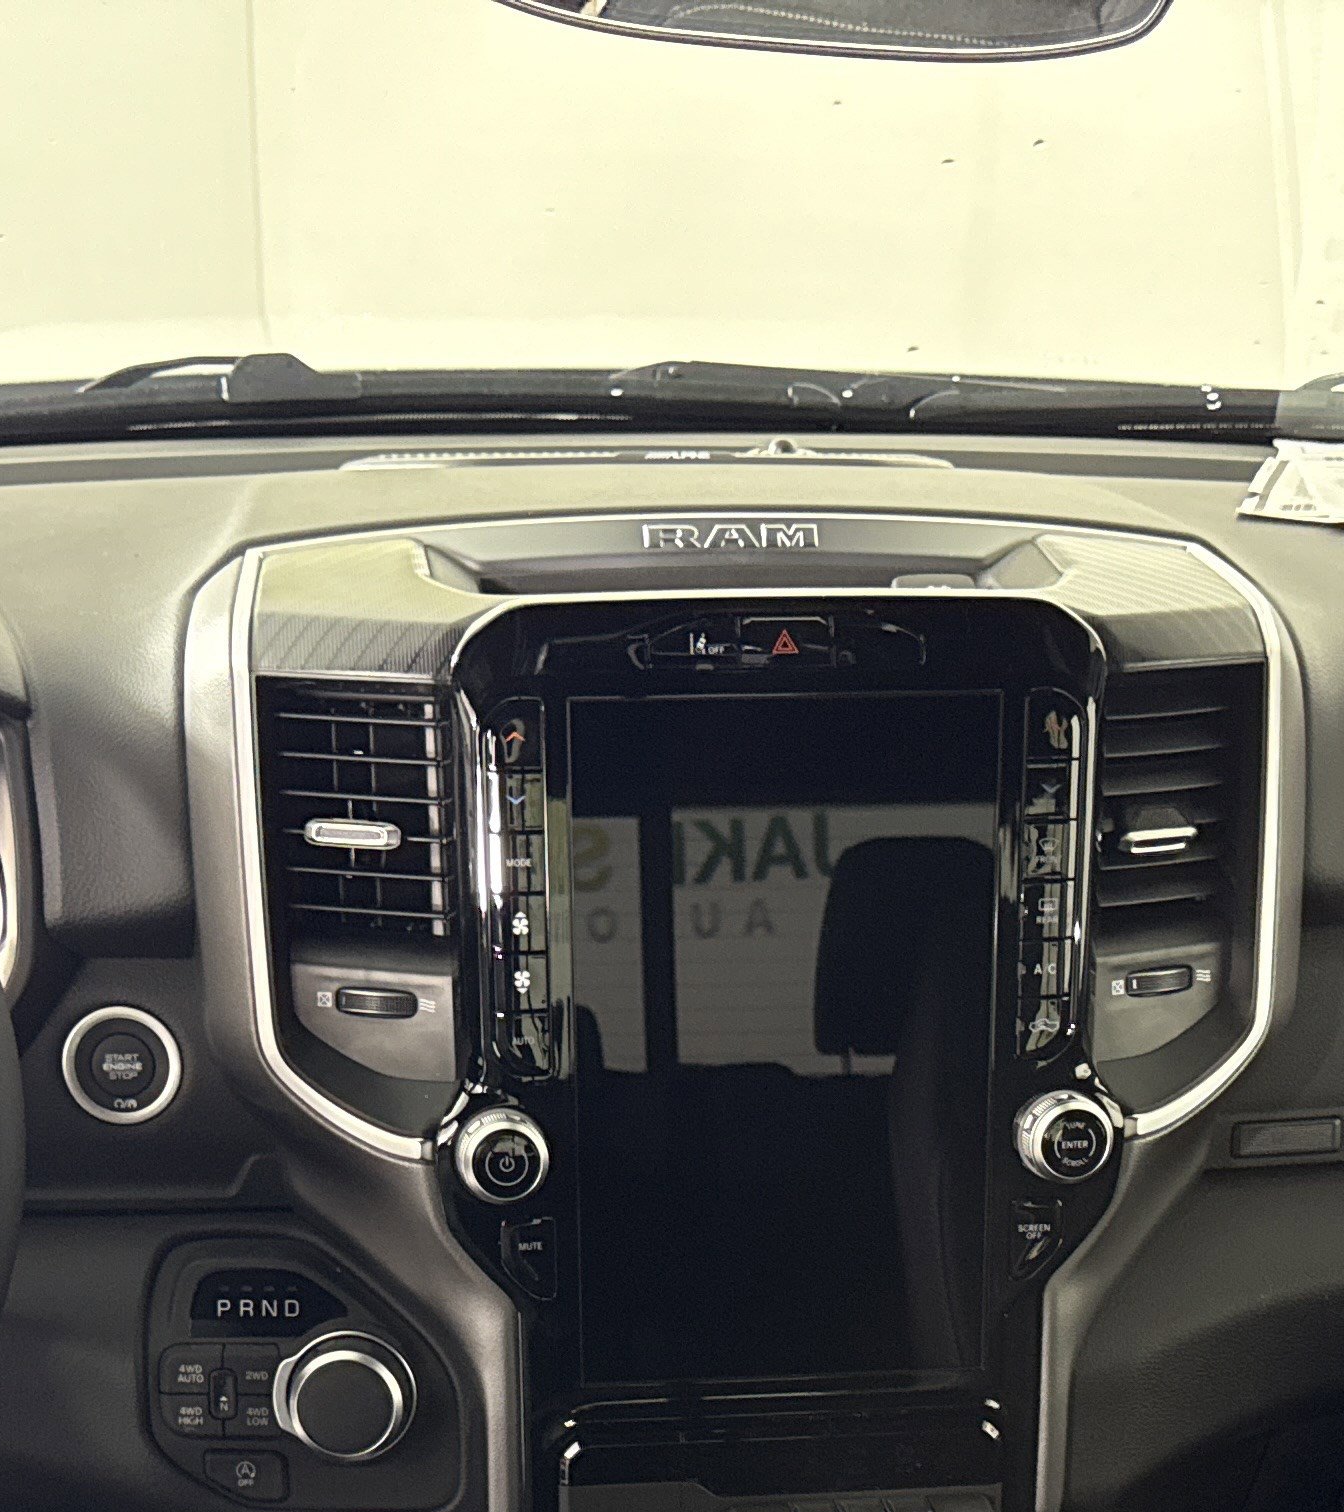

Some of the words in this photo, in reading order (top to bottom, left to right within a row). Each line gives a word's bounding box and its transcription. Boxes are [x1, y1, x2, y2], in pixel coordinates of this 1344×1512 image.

[642, 523, 819, 549] RAM
[506, 859, 532, 867] MODE
[1033, 963, 1057, 975] AC
[512, 1036, 534, 1045] AUTO
[1062, 1140, 1089, 1149] ENTER
[1018, 1223, 1051, 1232] SCREEN
[1025, 1232, 1042, 1240] OFF
[518, 1241, 543, 1251] MUTE
[217, 1299, 231, 1317] P
[239, 1299, 254, 1317] R
[261, 1299, 278, 1317] N
[284, 1299, 300, 1317] D
[178, 1364, 203, 1373] 4WD
[177, 1374, 204, 1383] AUTO
[245, 1371, 269, 1380] 2WD
[179, 1406, 203, 1415] 4WD
[246, 1407, 269, 1416] 4WD
[178, 1415, 204, 1426] HIGH
[246, 1416, 269, 1426] LOW
